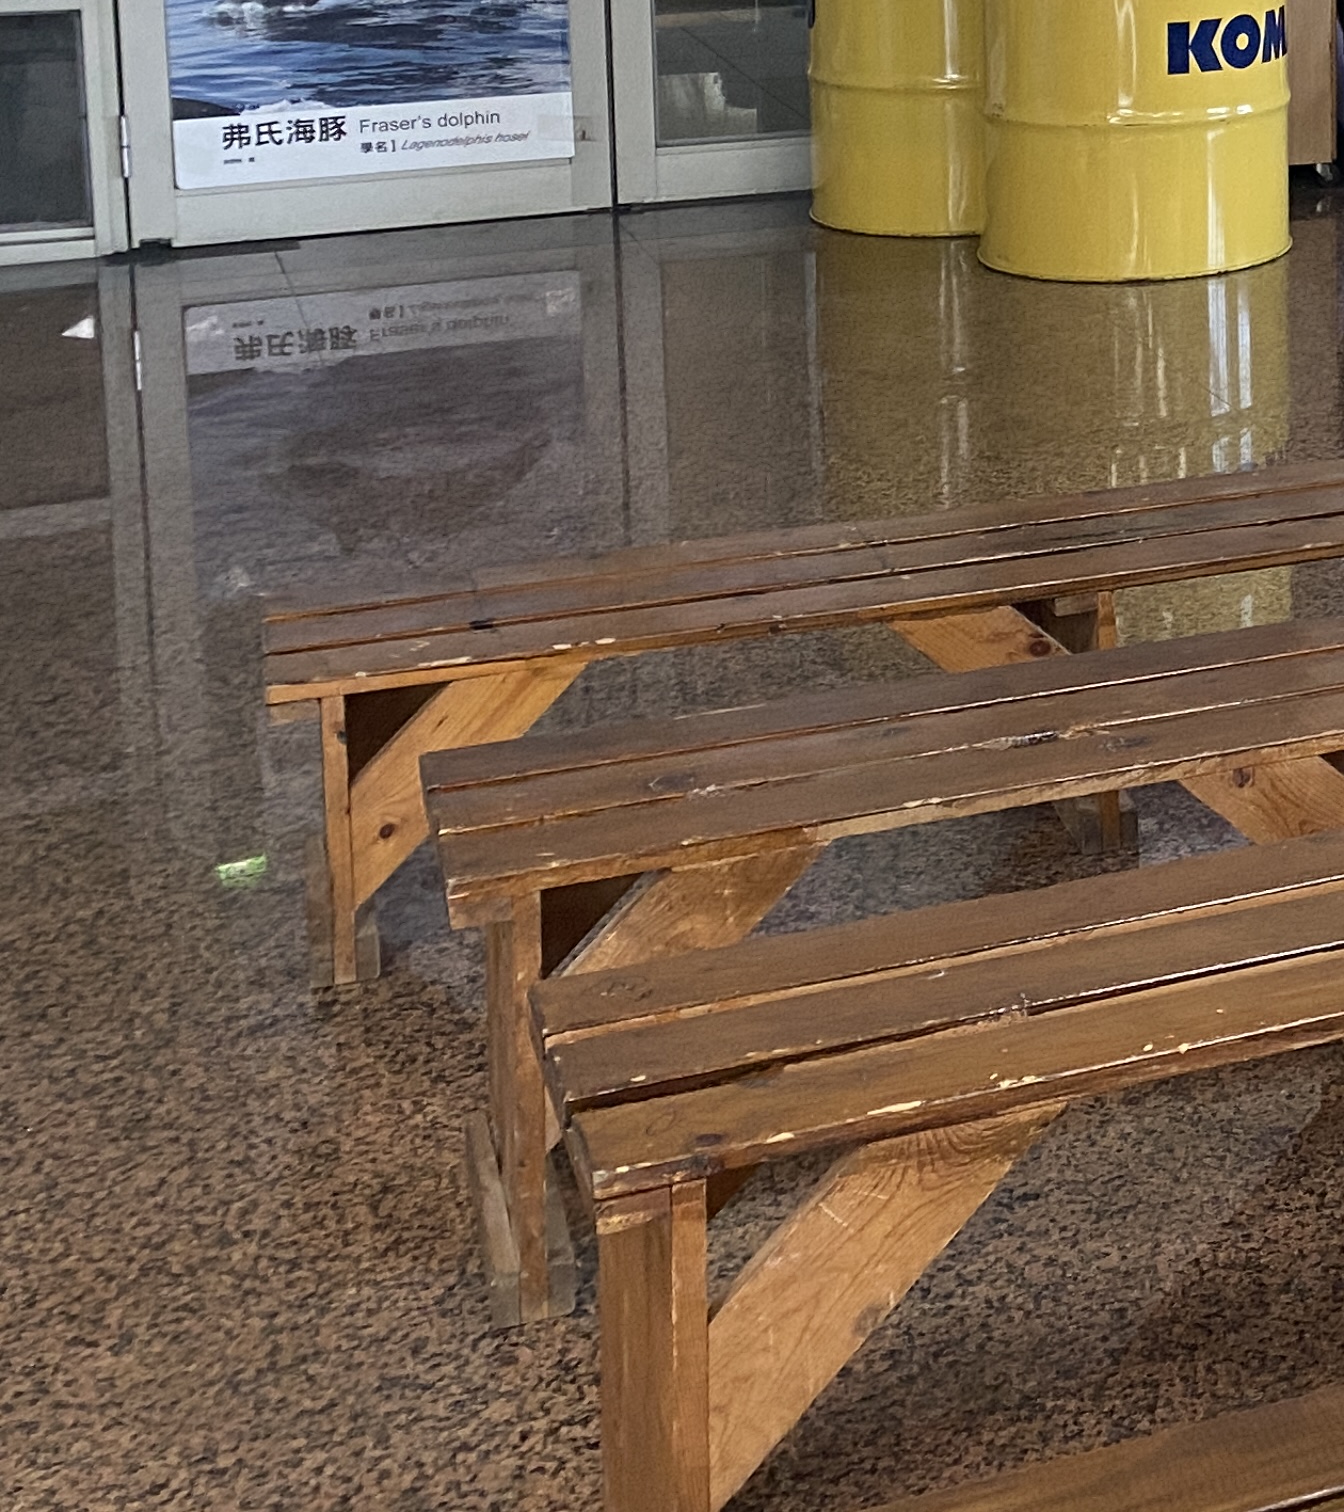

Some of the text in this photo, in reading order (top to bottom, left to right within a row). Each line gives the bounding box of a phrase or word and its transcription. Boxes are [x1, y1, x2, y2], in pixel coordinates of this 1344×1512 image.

[1167, 5, 1288, 76] KOM
[222, 110, 500, 150] 弗氏海豚 Fraser's dolphin
[401, 134, 492, 152] Lagenodelphis
